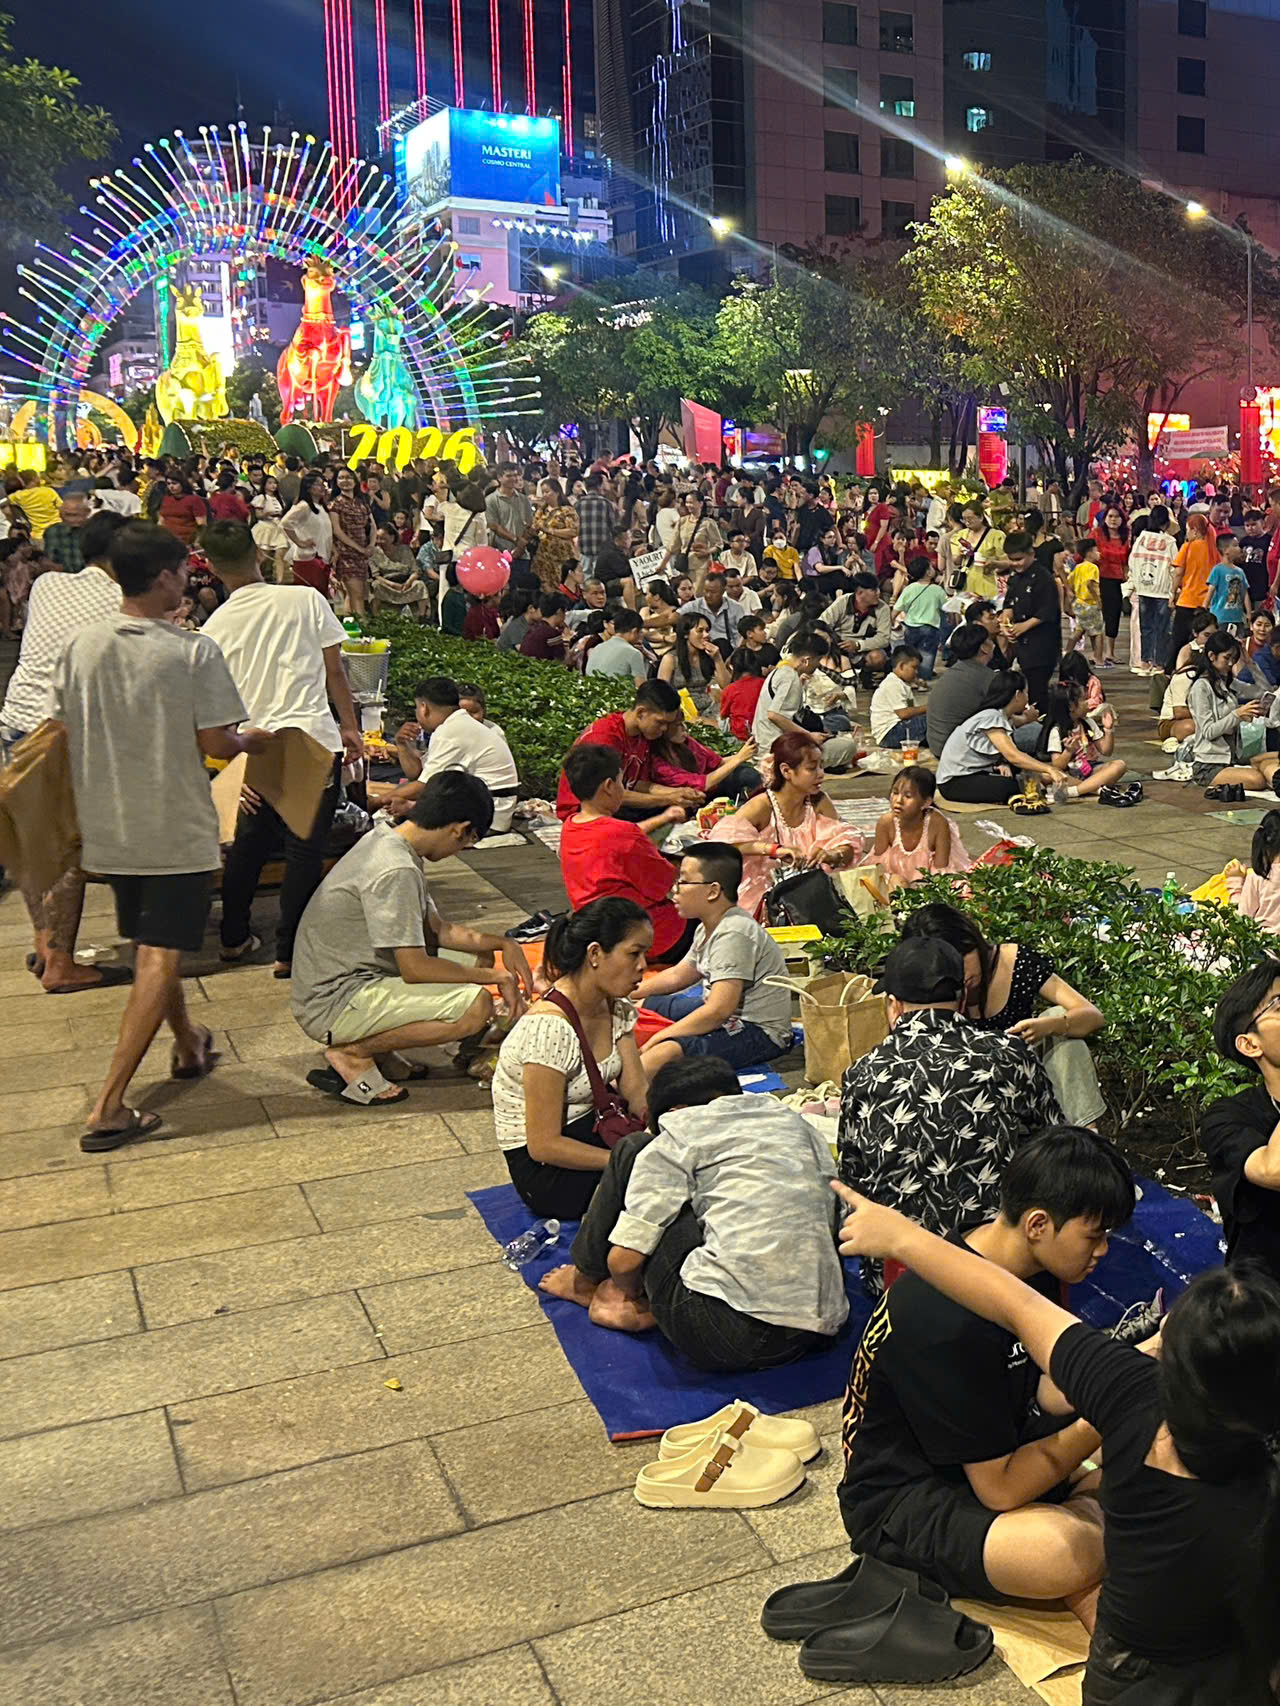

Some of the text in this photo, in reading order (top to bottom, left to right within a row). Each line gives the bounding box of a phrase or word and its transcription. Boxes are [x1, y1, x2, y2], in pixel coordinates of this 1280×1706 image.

[481, 144, 532, 160] MASTERI
[481, 158, 532, 169] COSMO CENTRAL
[346, 423, 477, 475] 2026
[632, 551, 664, 567] YAOURT
